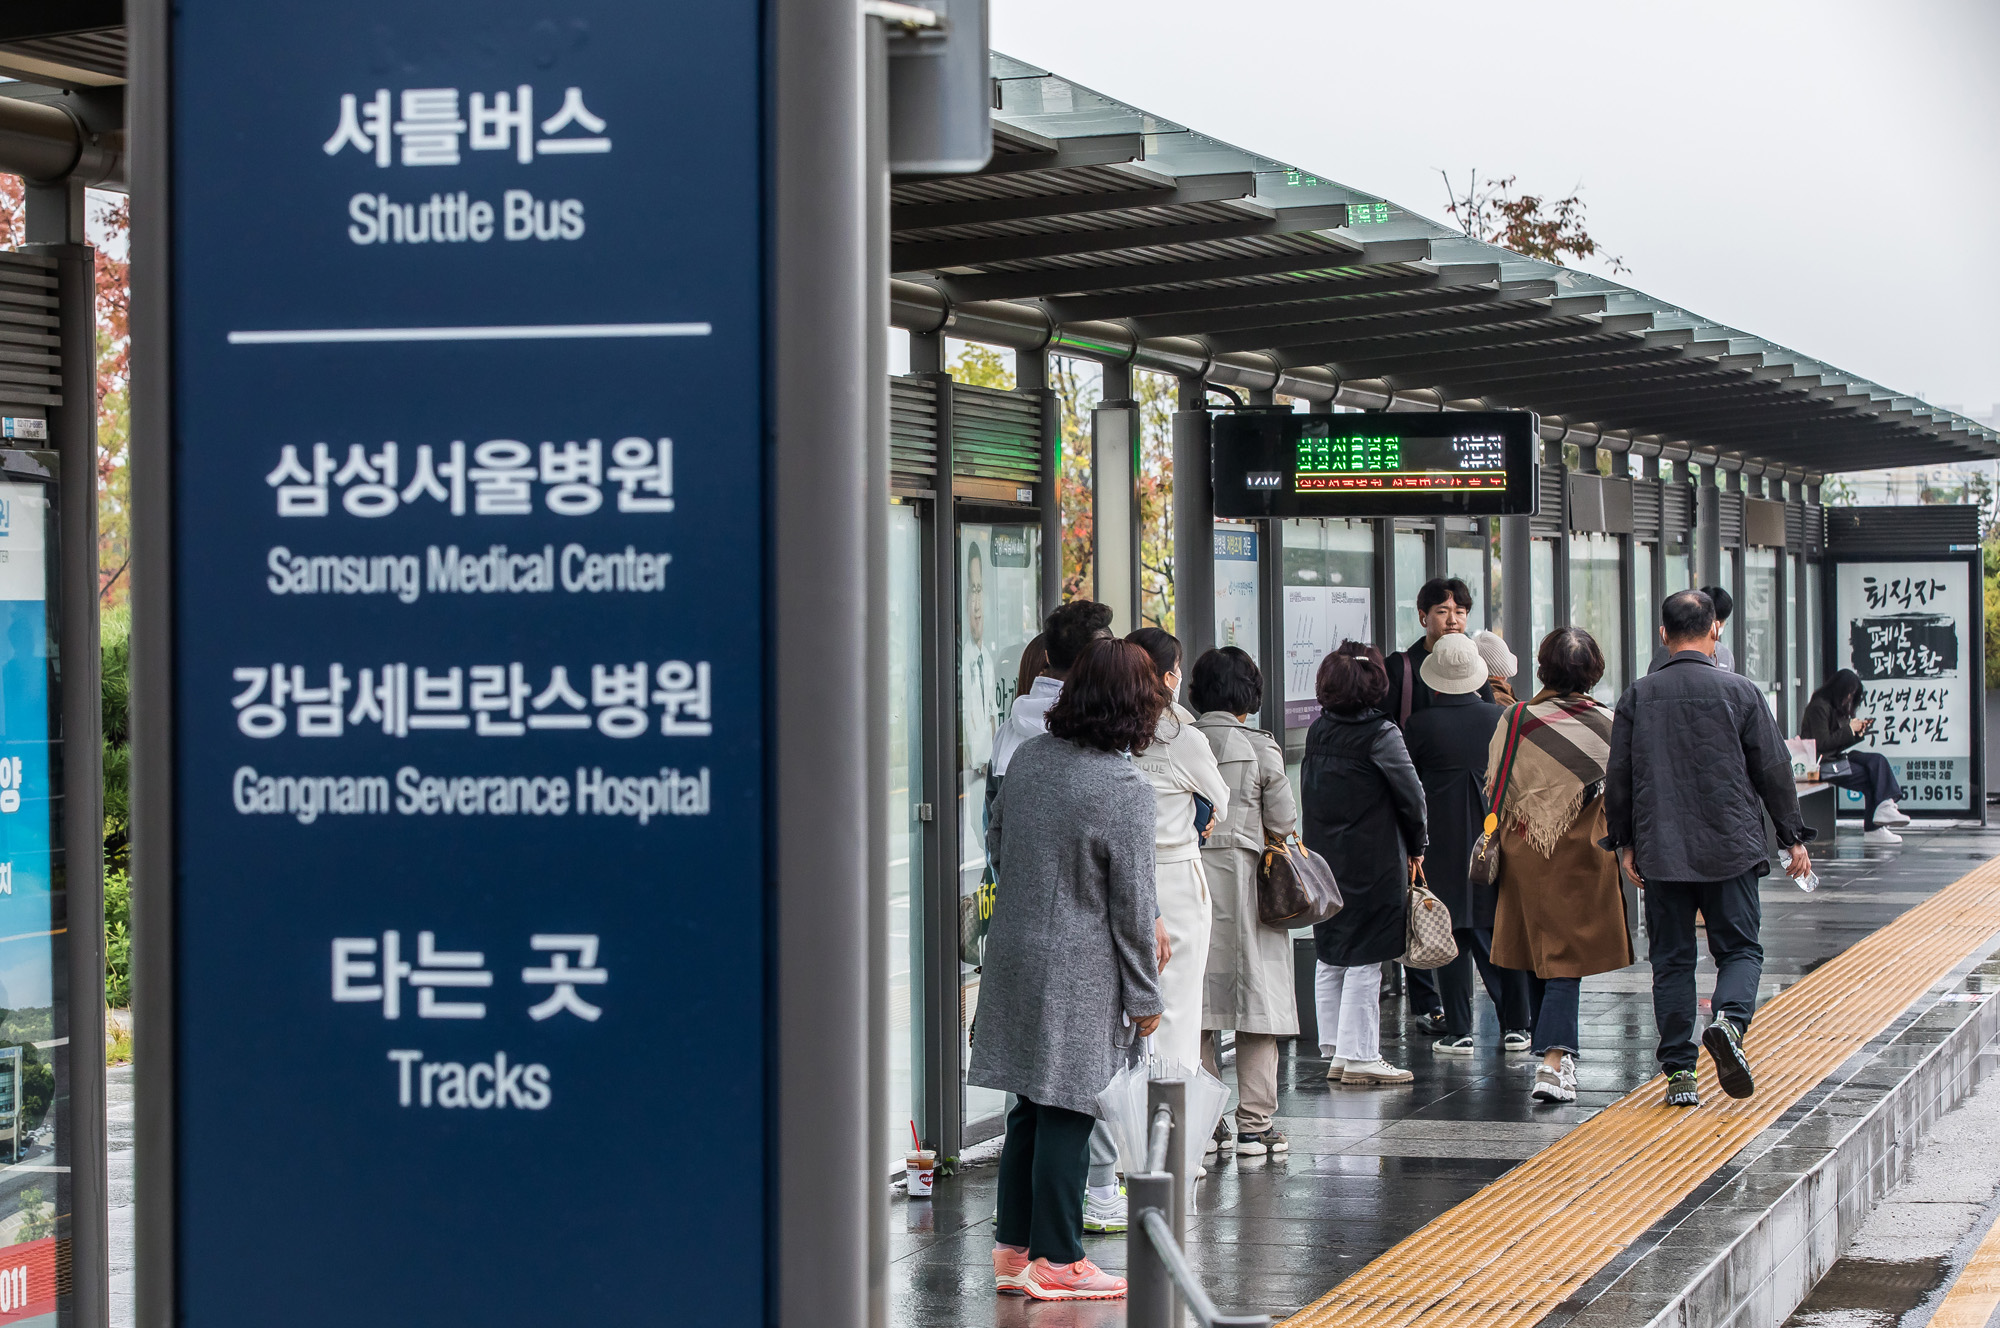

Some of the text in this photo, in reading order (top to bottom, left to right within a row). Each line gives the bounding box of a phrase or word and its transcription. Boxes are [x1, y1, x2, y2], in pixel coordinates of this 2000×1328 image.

[324, 84, 612, 168] 셔틀버스
[348, 190, 585, 244] Shuttle Bus
[266, 437, 674, 517] 삼성서울병원
[268, 544, 671, 603] Samsung Medical Center
[1863, 577, 1947, 610] 퇴직자
[1867, 622, 1912, 650] 폐암
[1870, 645, 1943, 675] 폐질환
[232, 661, 711, 738] 강남세브란스병원
[1861, 687, 1949, 715] 직업병보상
[1864, 714, 1949, 747] 무료상담
[1906, 760, 1936, 771] 삼성병원
[1939, 760, 1954, 770] 정문
[234, 767, 709, 823] Gangnam Severance Hospital
[332, 930, 608, 1021] 타는 곳
[388, 1050, 550, 1109] Tracks
